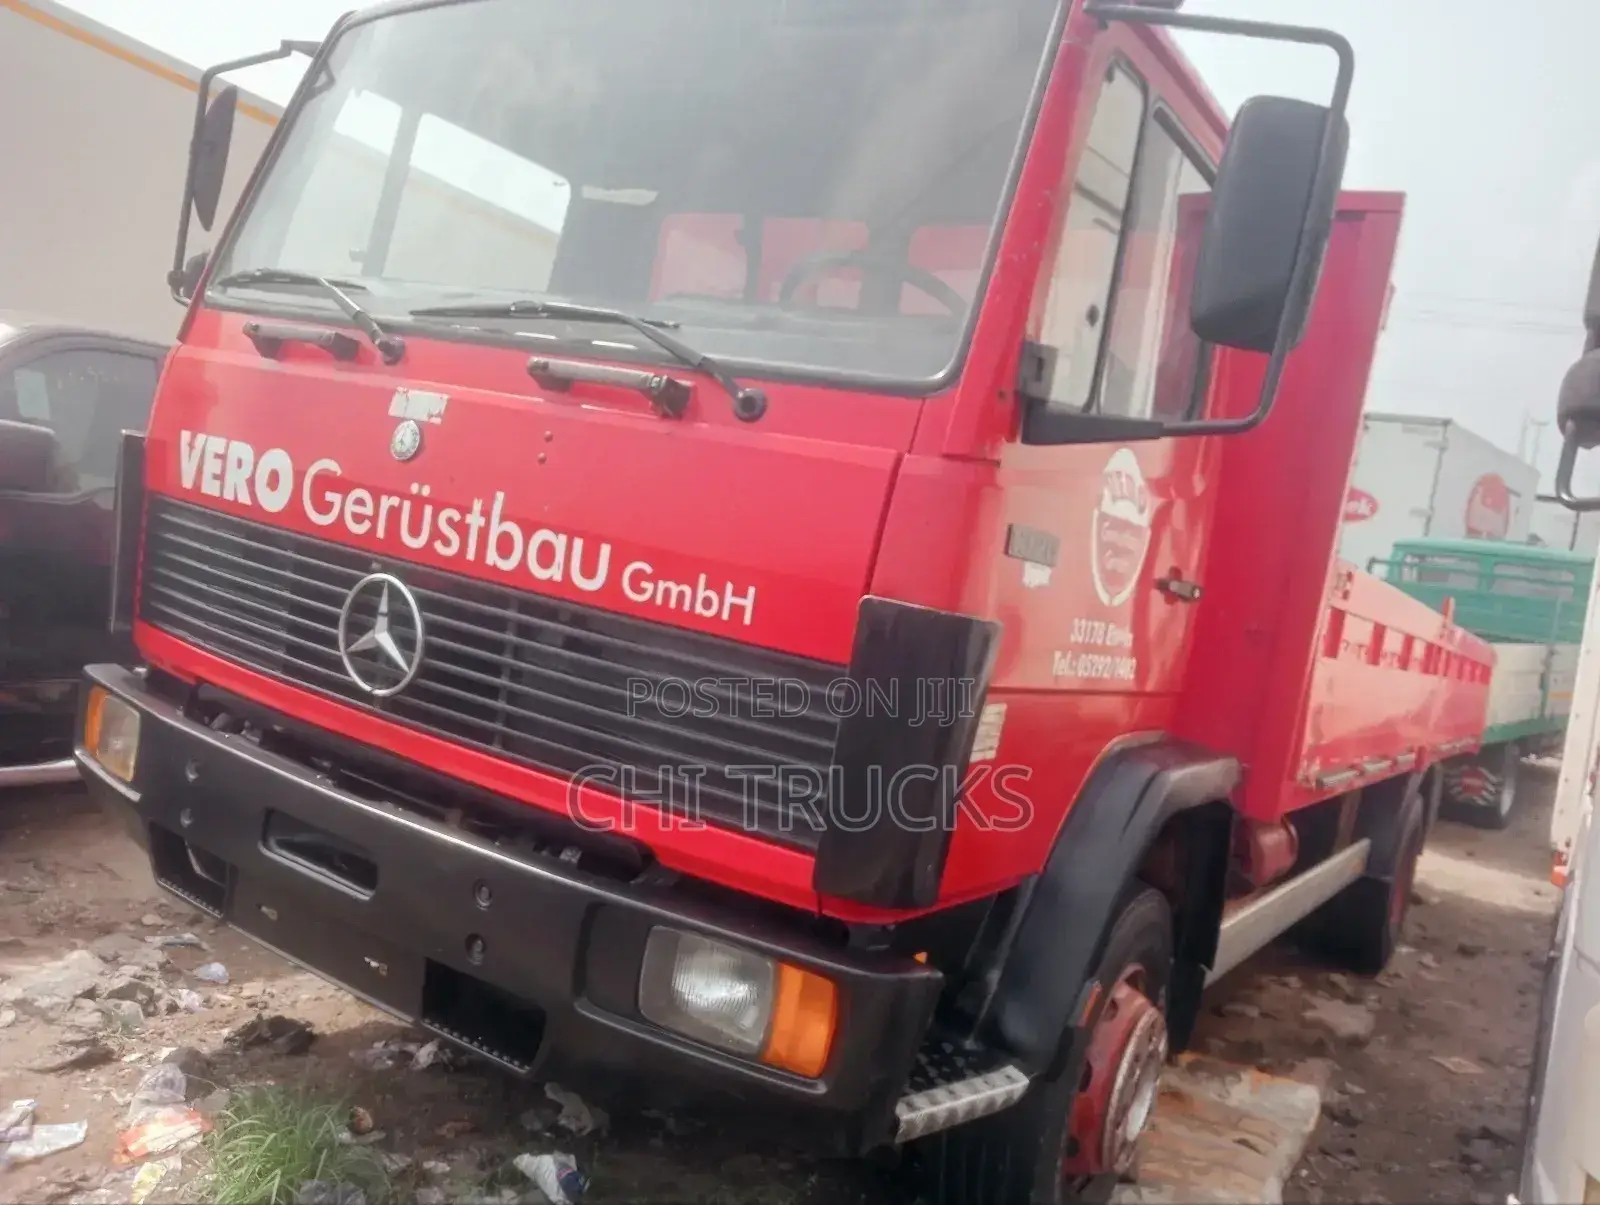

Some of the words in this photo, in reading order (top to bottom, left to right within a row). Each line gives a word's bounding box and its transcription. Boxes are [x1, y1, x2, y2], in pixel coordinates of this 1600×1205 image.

[180, 429, 294, 513] VERO
[303, 458, 612, 592] Gerüstbau
[621, 561, 756, 626] GmbH
